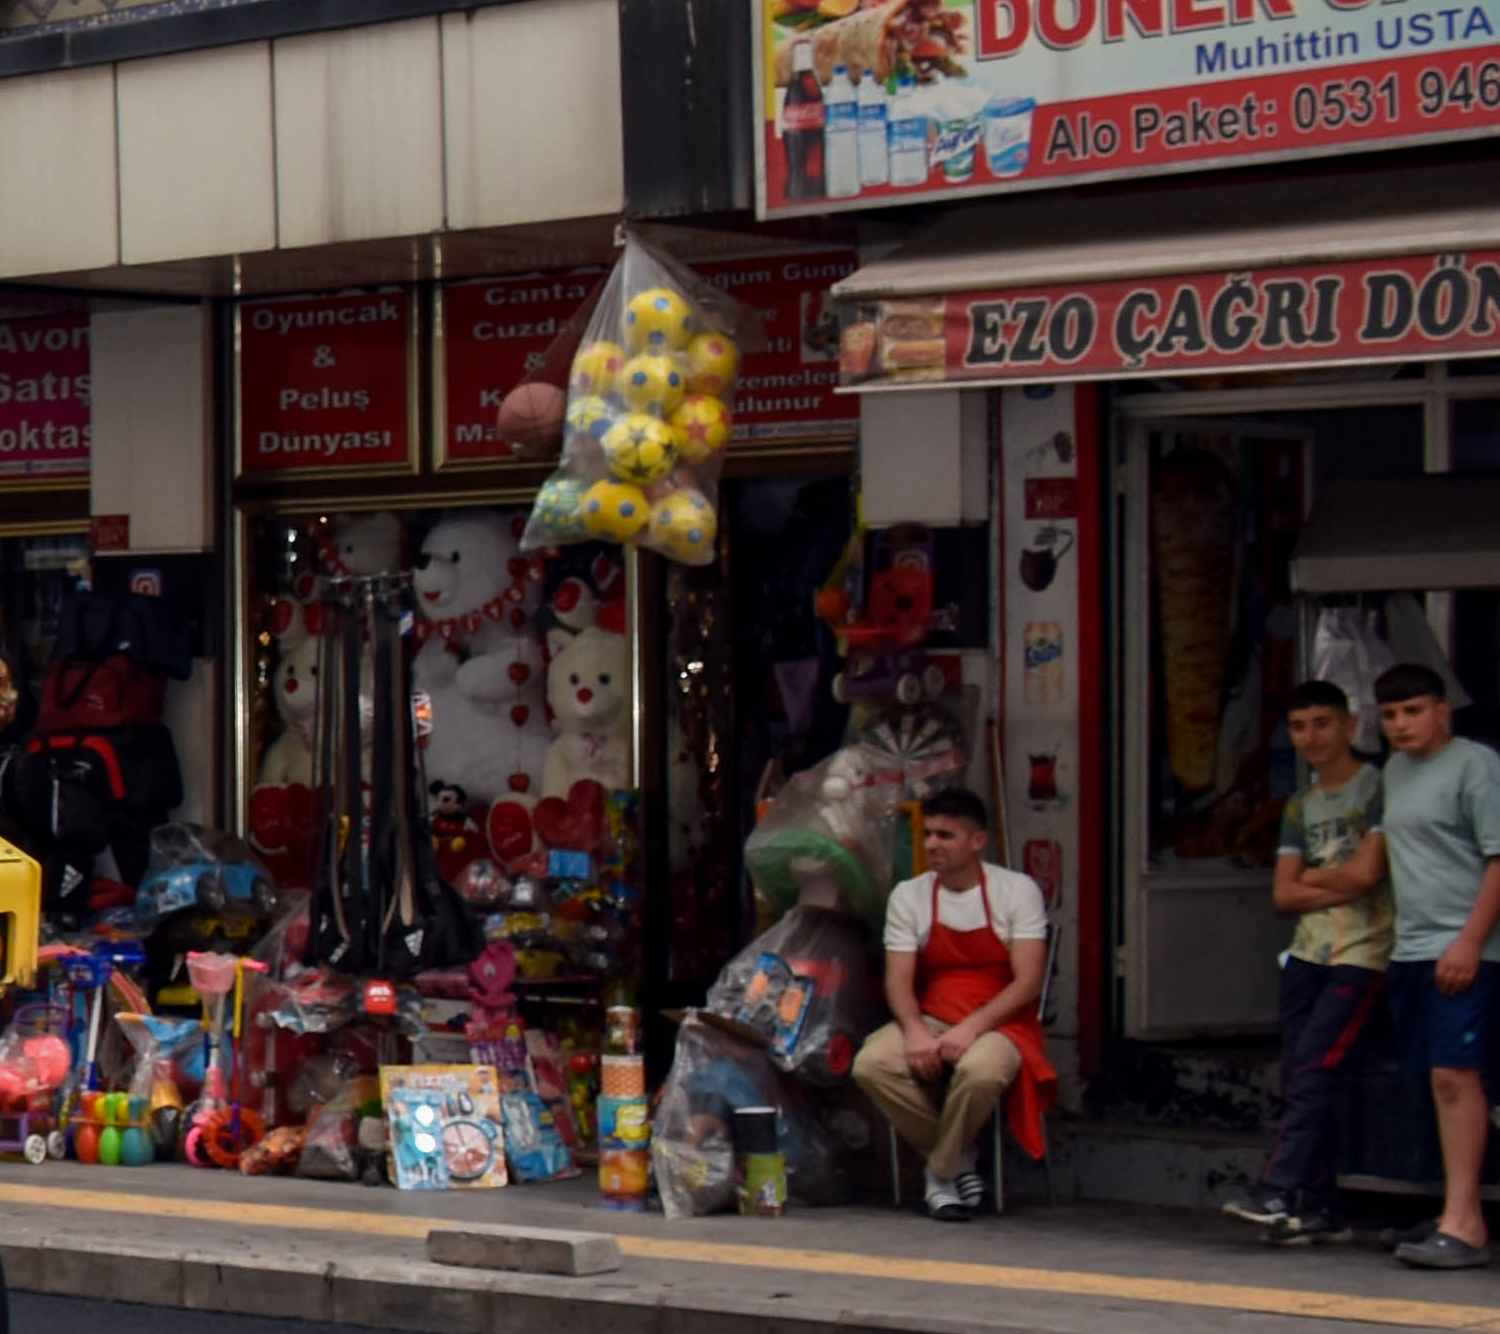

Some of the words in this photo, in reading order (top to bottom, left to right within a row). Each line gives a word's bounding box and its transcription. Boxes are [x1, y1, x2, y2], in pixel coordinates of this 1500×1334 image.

[1196, 28, 1359, 75] Muhittin
[1377, 5, 1494, 49] USTA
[1047, 115, 1118, 162] Alo
[1294, 73, 1399, 130] 0531
[253, 299, 399, 335] Oyuncak
[965, 296, 1097, 366] EZO
[1114, 272, 1342, 366] ÇAĞRI
[313, 345, 336, 368] &
[279, 387, 370, 412] Peluş
[259, 430, 393, 455] Dünyası
